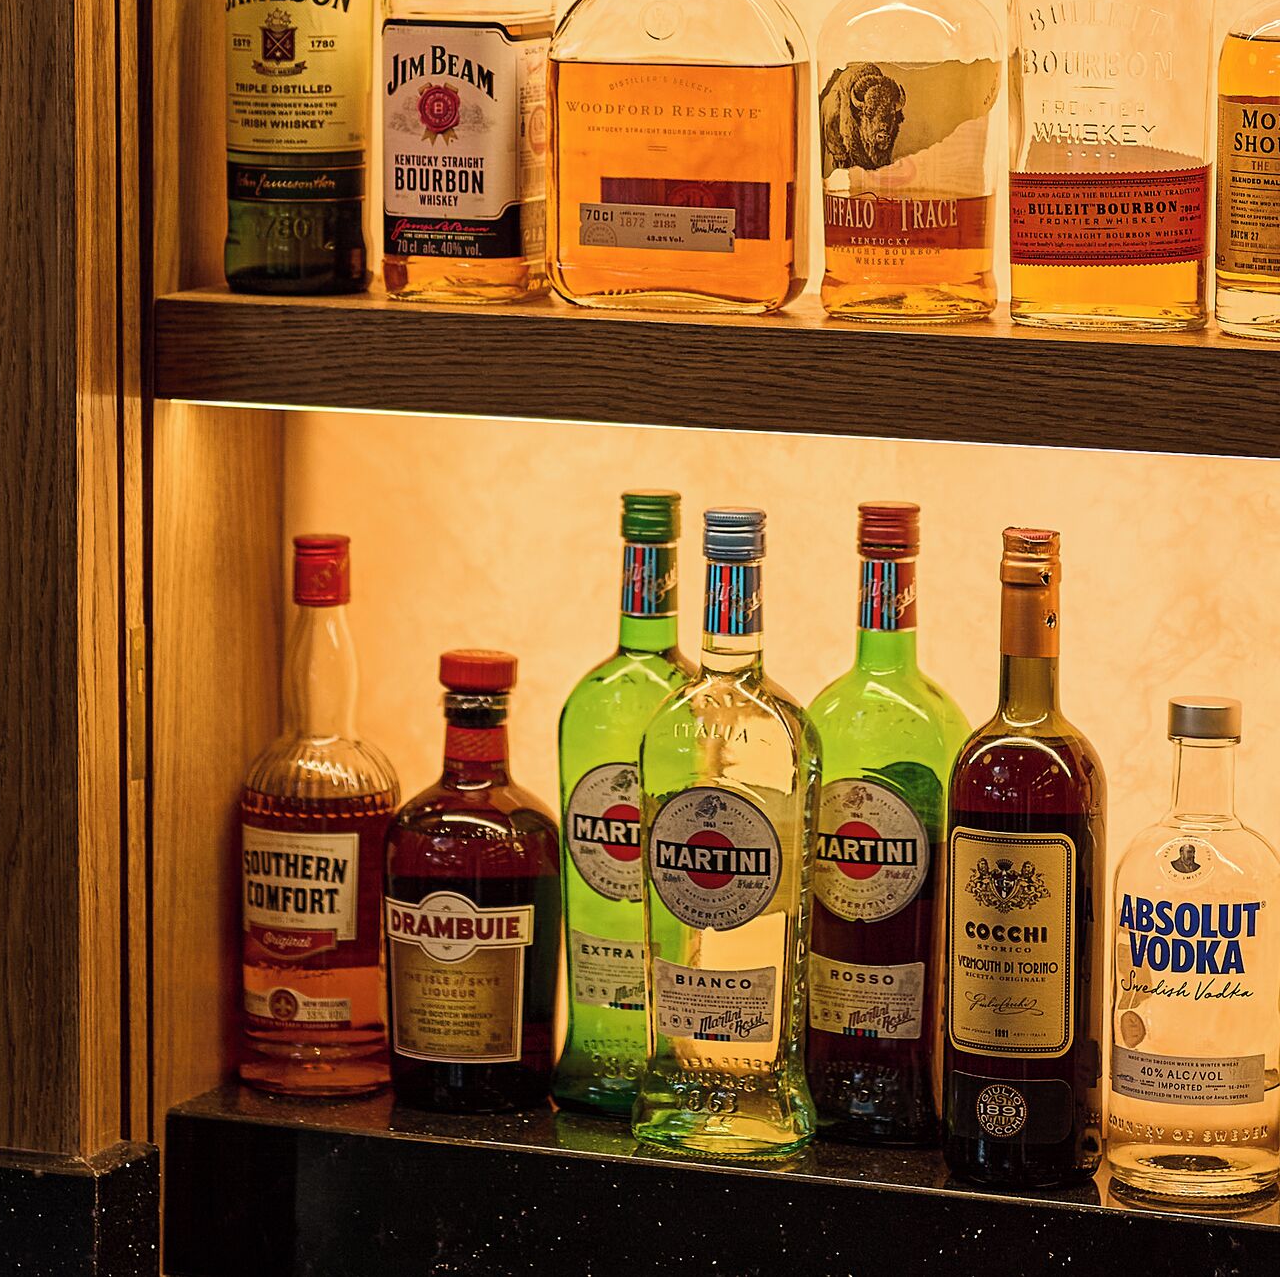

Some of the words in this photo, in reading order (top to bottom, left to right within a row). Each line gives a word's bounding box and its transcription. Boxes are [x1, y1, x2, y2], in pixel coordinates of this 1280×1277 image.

[386, 52, 425, 96] JIM
[430, 44, 495, 100] BEAM
[235, 82, 268, 94] TRIPLE
[271, 84, 332, 94] DISTILLED
[565, 100, 664, 116] WOODFORD
[672, 105, 758, 120] RESERVE
[240, 118, 267, 129] IRISH
[270, 119, 325, 129] WHISKEY
[1032, 121, 1157, 146] WHISKEY
[394, 153, 439, 168] KENTUCKY
[441, 155, 485, 169] STRAIGHT
[1251, 160, 1270, 171] THE
[394, 167, 485, 195] BOURBON
[1231, 176, 1262, 185] BLENDED
[419, 194, 459, 207] WHISKEY
[1028, 202, 1089, 216] BULLEIT
[1096, 200, 1178, 215] BOURBON
[585, 209, 614, 222] 70cl
[899, 197, 958, 232] TRACE
[1039, 217, 1100, 226] FRONTIER
[1105, 216, 1165, 225] WHISKEY
[1155, 228, 1194, 237] WHISKEY
[1230, 229, 1249, 240] BATCH
[1250, 231, 1259, 241] 27
[396, 238, 409, 254] 70
[410, 239, 418, 253] cl
[422, 240, 439, 254] alc.
[440, 240, 463, 255] 40%
[464, 241, 483, 256] vol.
[850, 236, 911, 246] KENTUCKY
[854, 257, 905, 266] WHISKEY
[576, 819, 641, 845] MART
[243, 848, 348, 884] SOUTHERN
[659, 843, 767, 873] MARTINI
[246, 879, 340, 915] COMFORT
[1119, 893, 1261, 939] ABSOLUT
[390, 908, 521, 941] DRAMBUIE
[965, 921, 1048, 944] COCCHI
[581, 944, 635, 959] EXTRA
[977, 944, 1032, 953] STORICO
[1128, 932, 1246, 975] VODKA
[958, 954, 1001, 974] VERMOUTH
[1004, 961, 1015, 974] DI
[1018, 961, 1059, 975] TORINO
[675, 974, 752, 990] BIANCO
[830, 969, 894, 985] ROSSO
[422, 986, 477, 998] LIQUEUR
[1120, 970, 1191, 999] Swedish
[1194, 978, 1254, 1001] Vodka
[1140, 1066, 1164, 1079] 40%
[1167, 1069, 1224, 1081] ALC/VOL
[1158, 1081, 1203, 1092] IMPORTED
[981, 1086, 1022, 1106] GIULIO
[980, 1103, 1026, 1117] 1891
[980, 1113, 1023, 1135] COCCHI
